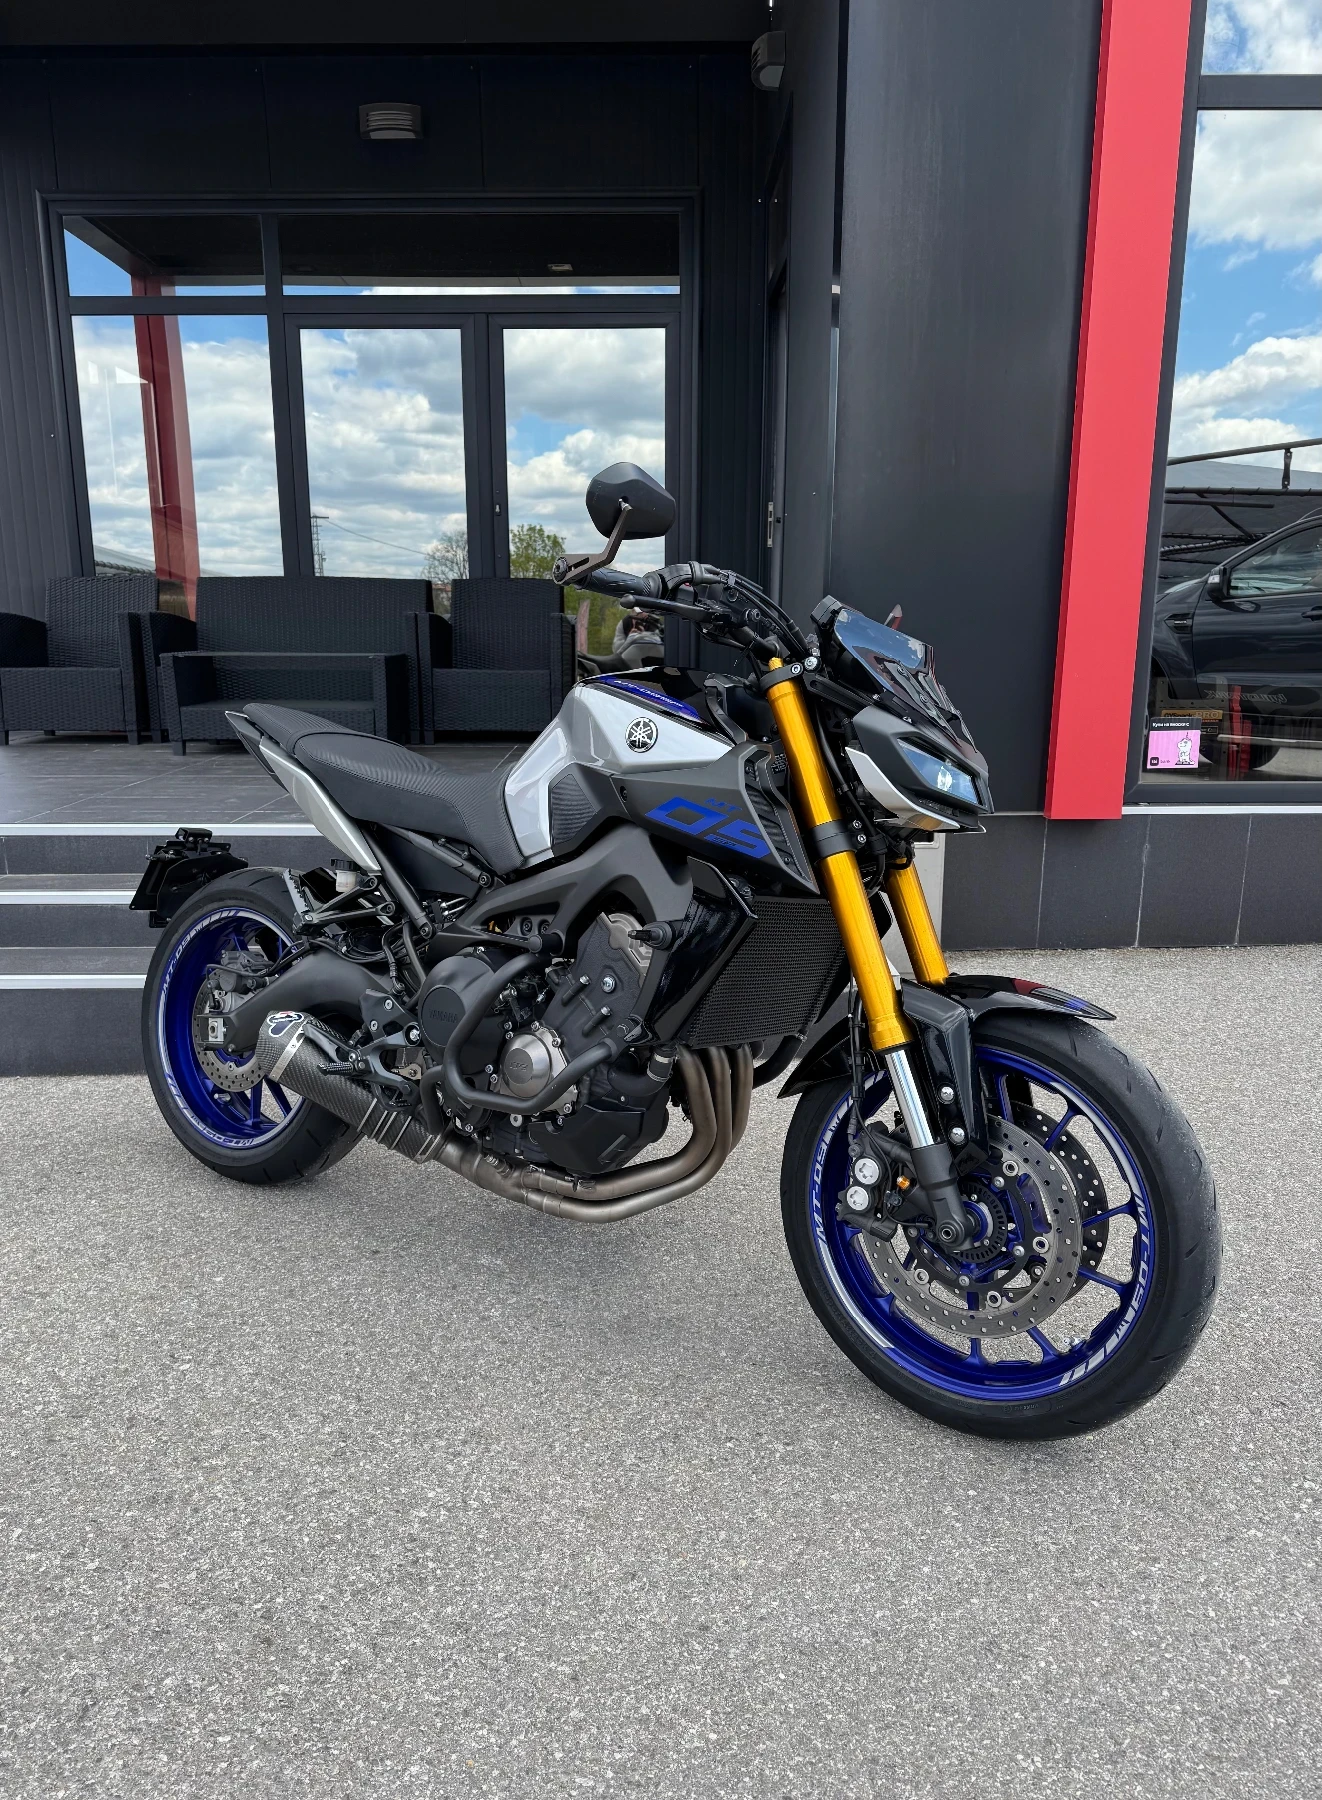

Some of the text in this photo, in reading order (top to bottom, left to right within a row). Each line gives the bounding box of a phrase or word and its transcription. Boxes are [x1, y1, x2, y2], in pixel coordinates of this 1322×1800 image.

[704, 797, 743, 812] MT
[428, 1008, 460, 1024] YAMAHA
[1132, 1193, 1151, 1309] MT-09
